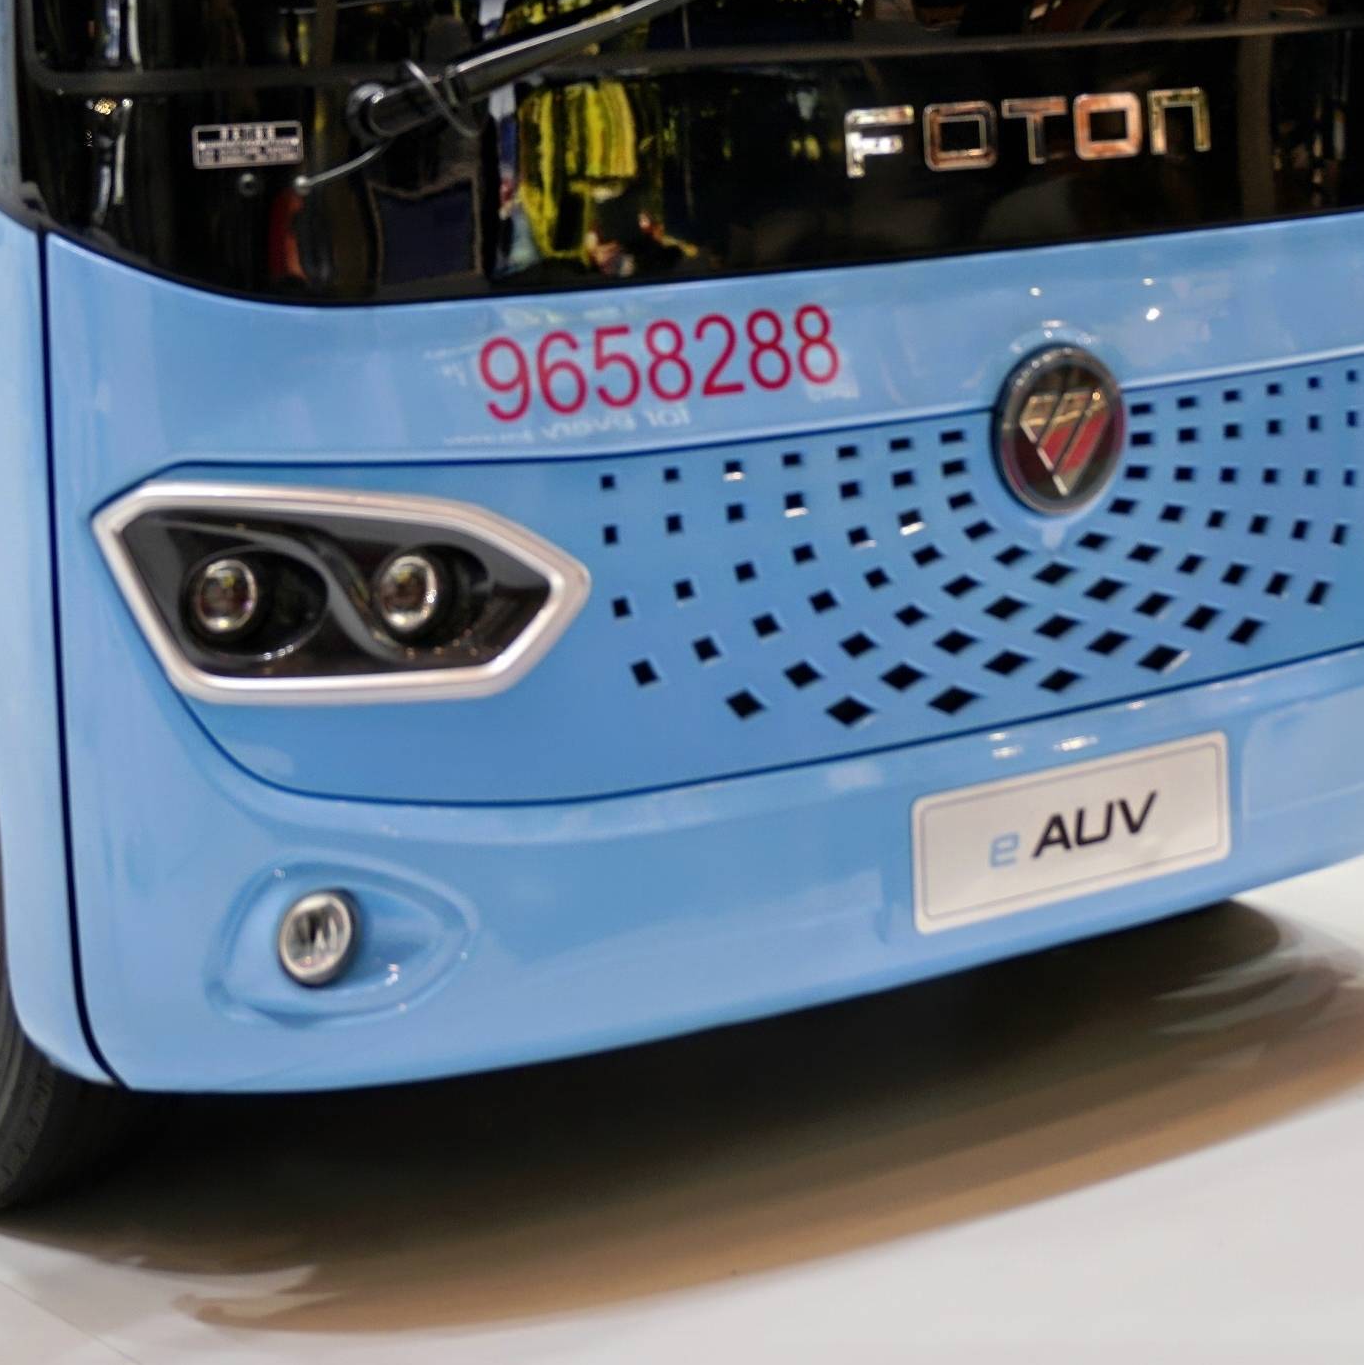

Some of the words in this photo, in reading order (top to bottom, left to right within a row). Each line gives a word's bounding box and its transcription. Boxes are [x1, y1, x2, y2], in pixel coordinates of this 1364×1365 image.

[844, 86, 1212, 178] FOTON
[476, 303, 841, 423] 9658288
[989, 831, 1019, 870] e
[1031, 791, 1158, 860] AUV
